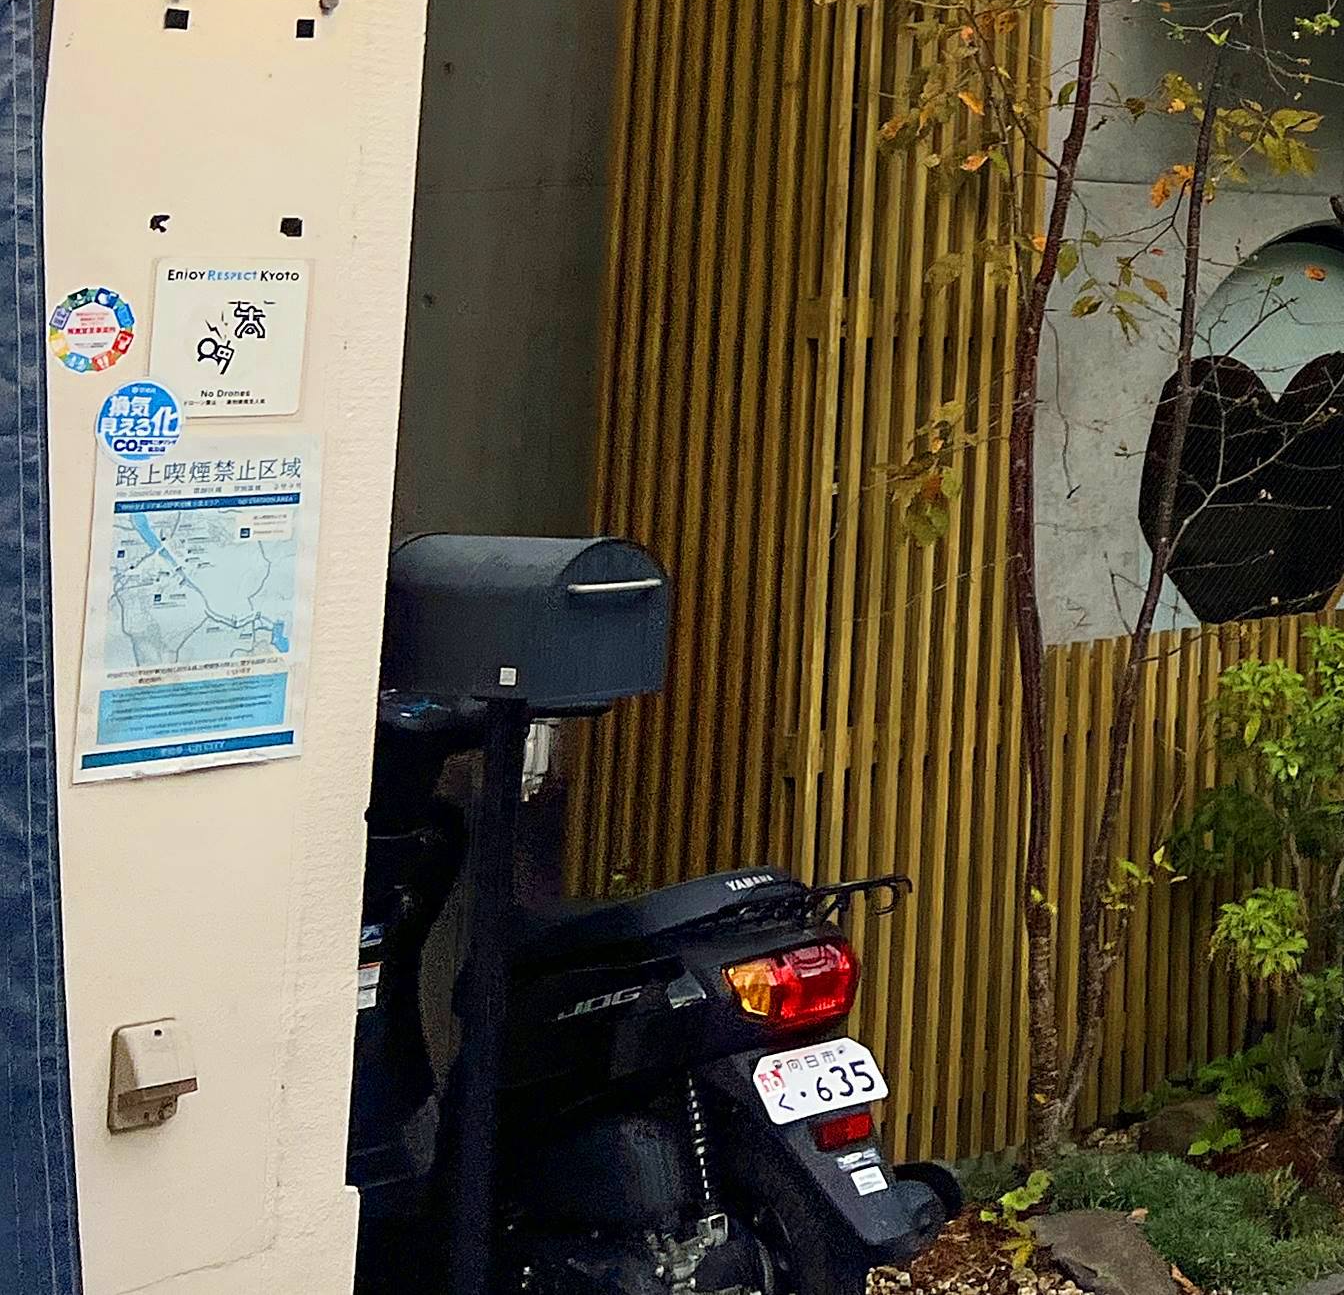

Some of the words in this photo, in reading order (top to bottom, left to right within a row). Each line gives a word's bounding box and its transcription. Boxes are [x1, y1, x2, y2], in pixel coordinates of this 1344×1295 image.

[201, 390, 214, 398] No
[217, 389, 250, 397] Drones
[109, 396, 152, 417] 換気
[115, 457, 301, 487] 路上喫煙禁止区域
[725, 874, 774, 891] YAMAHA
